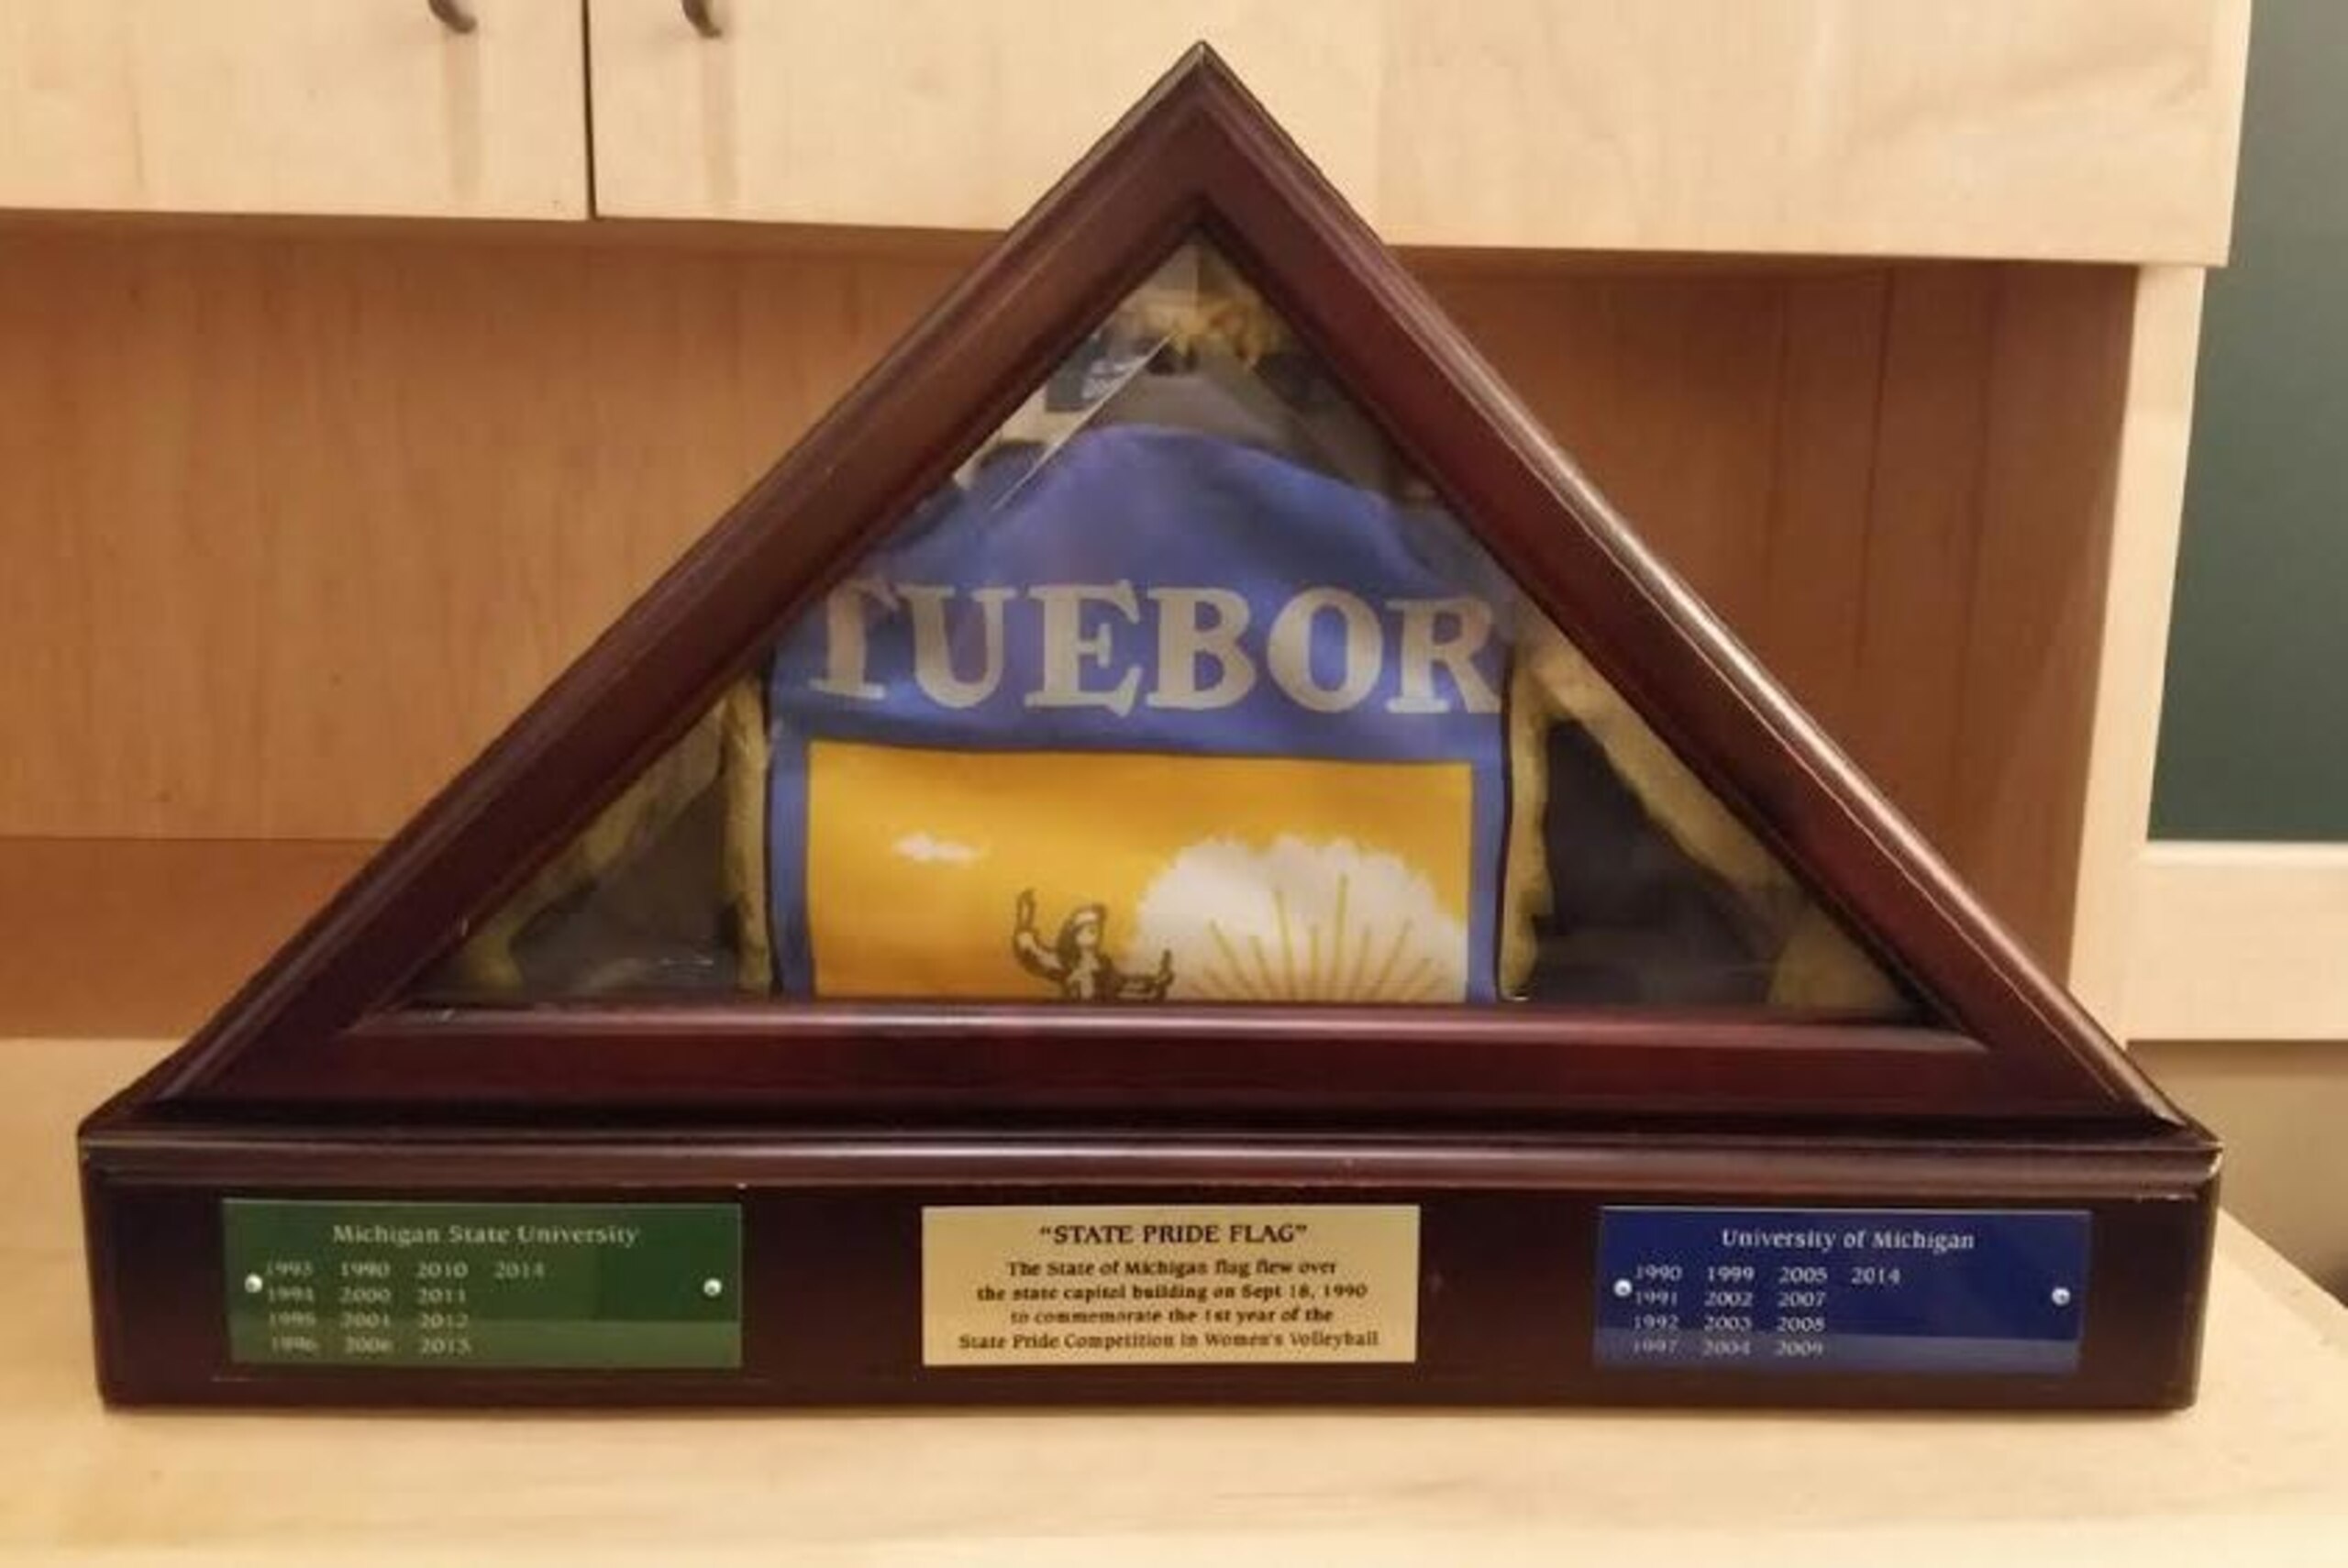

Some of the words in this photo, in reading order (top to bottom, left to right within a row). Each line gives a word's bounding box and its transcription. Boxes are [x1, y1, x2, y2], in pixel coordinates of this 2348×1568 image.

[810, 576, 1501, 716] TUEBOR
[333, 1225, 439, 1248] Michigan
[449, 1225, 511, 1244] State
[517, 1225, 640, 1249] University
[1143, 1225, 1220, 1243] PRIDE
[1721, 1227, 1834, 1253] University
[1843, 1229, 1866, 1249] of
[1872, 1231, 1976, 1255] Michigan
[417, 1261, 469, 1278] 2010
[493, 1261, 545, 1279] 2014
[1007, 1261, 1041, 1276] The
[1047, 1261, 1095, 1276] State
[1100, 1260, 1120, 1275] of
[1124, 1260, 1208, 1279] Michigan
[1215, 1259, 1250, 1278] flag
[1256, 1258, 1293, 1275] flew
[1298, 1261, 1337, 1275] over
[1635, 1264, 1683, 1281] 1990
[1707, 1266, 1755, 1282] 1999
[1778, 1266, 1828, 1285] 2005
[1851, 1266, 1902, 1285] 2014
[338, 1286, 392, 1304] 2000
[417, 1286, 466, 1304] 2011
[977, 1286, 1006, 1301] the
[1013, 1286, 1058, 1301] state
[1063, 1284, 1126, 1303] capitol
[1133, 1284, 1207, 1303] building
[1213, 1286, 1236, 1298] on
[1241, 1283, 1281, 1302] Sept
[1324, 1284, 1369, 1299] 1990
[1634, 1291, 1678, 1306] 1991
[1703, 1291, 1754, 1308] 2002
[1777, 1291, 1827, 1308] 2007
[339, 1310, 390, 1330] 2001
[1010, 1309, 1030, 1324] to
[1034, 1309, 1162, 1324] commemorate
[1168, 1307, 1198, 1322] the
[1205, 1308, 1231, 1322] 1st
[1235, 1309, 1276, 1327] year
[1280, 1307, 1301, 1321] of
[1305, 1308, 1334, 1322] the
[1634, 1314, 1679, 1330] 1992
[1777, 1316, 1825, 1332] 2008
[958, 1332, 1006, 1349] State
[1013, 1332, 1058, 1349] Pride
[1063, 1332, 1173, 1351] Competition
[1180, 1331, 1198, 1346] in
[1204, 1331, 1285, 1347] Women's
[1289, 1330, 1380, 1351] Volleyball
